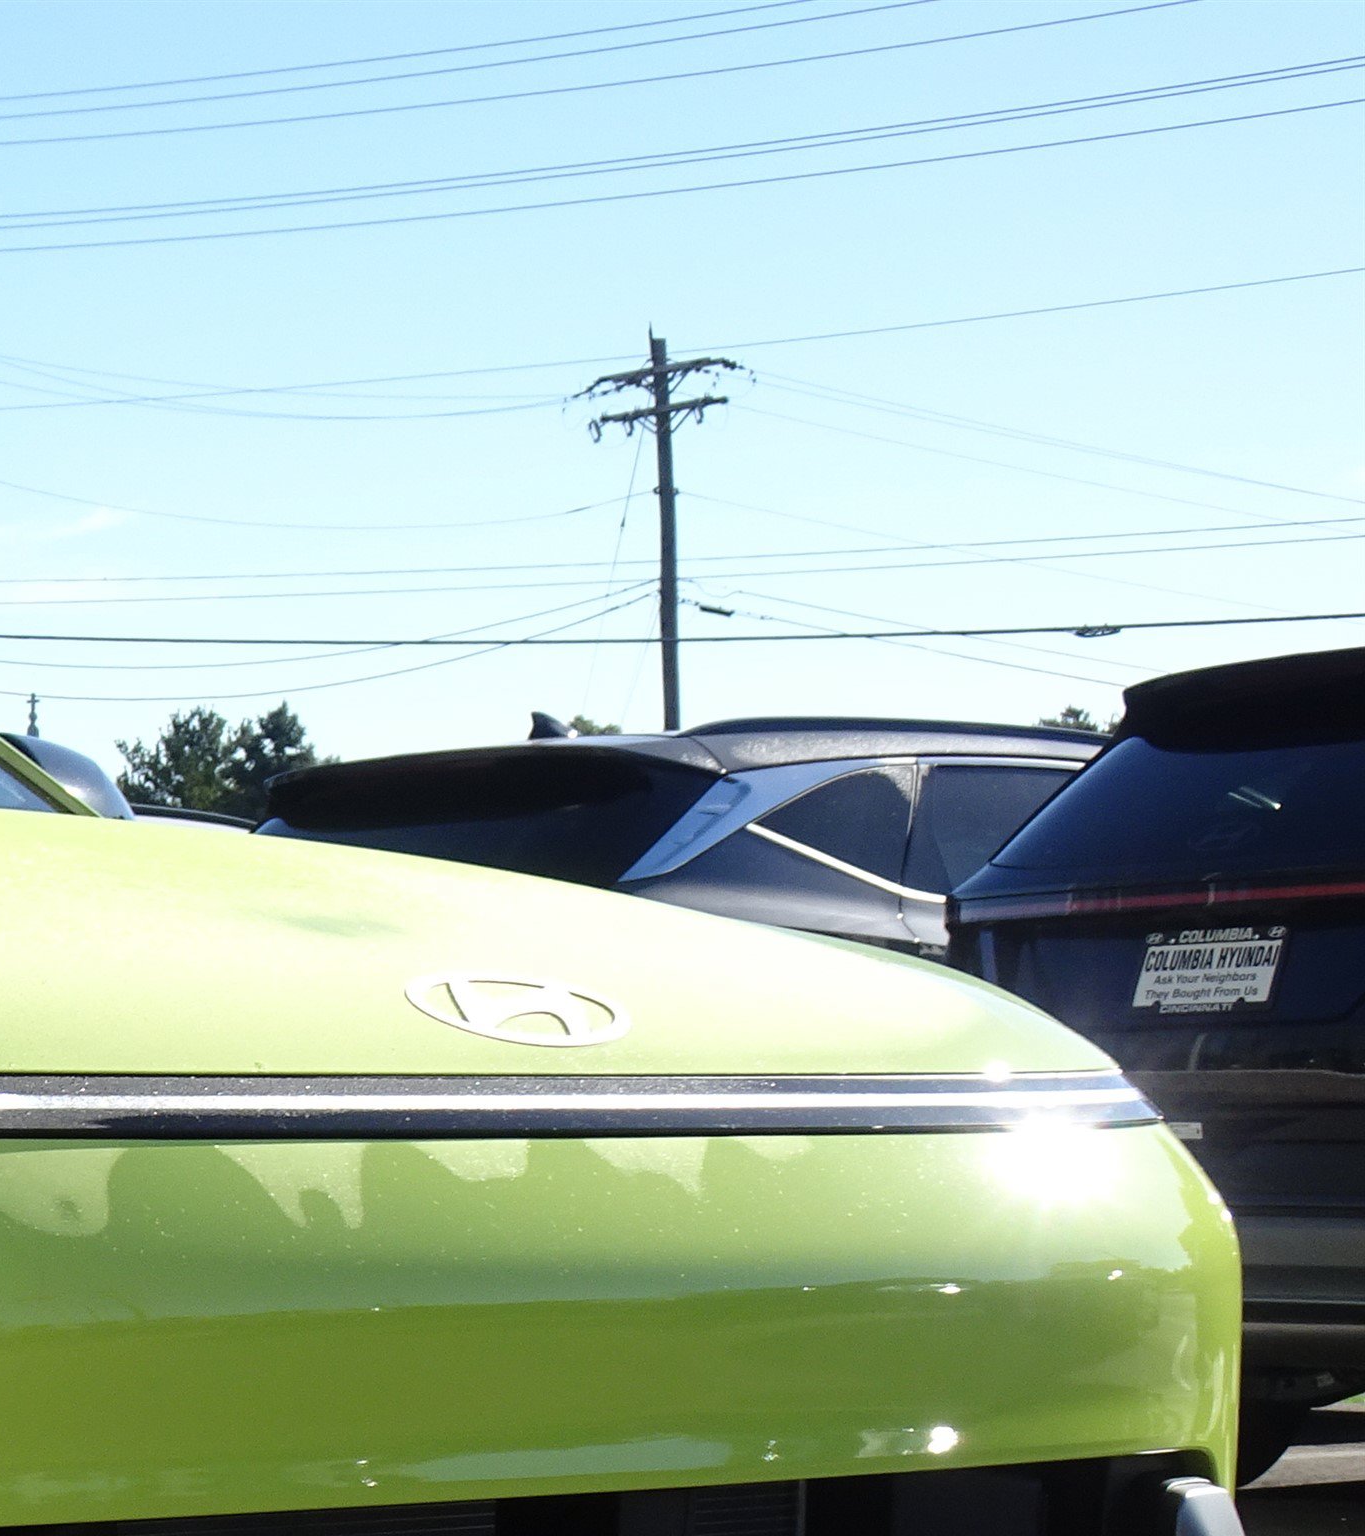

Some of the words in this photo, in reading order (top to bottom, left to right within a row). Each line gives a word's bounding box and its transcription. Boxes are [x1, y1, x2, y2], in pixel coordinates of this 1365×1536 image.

[1179, 927, 1253, 943] COLUMBIA
[1145, 948, 1214, 972] COLUMBIA
[1217, 944, 1280, 968] HYUNDAI
[1153, 975, 1173, 985] Ask
[1176, 973, 1200, 984] Your
[1201, 971, 1257, 985] Neighbors
[1145, 989, 1169, 1001] They
[1172, 988, 1211, 1000] Bought
[1213, 986, 1241, 997] From
[1244, 986, 1258, 996] Us
[1159, 1003, 1235, 1014] CINCINNATI
